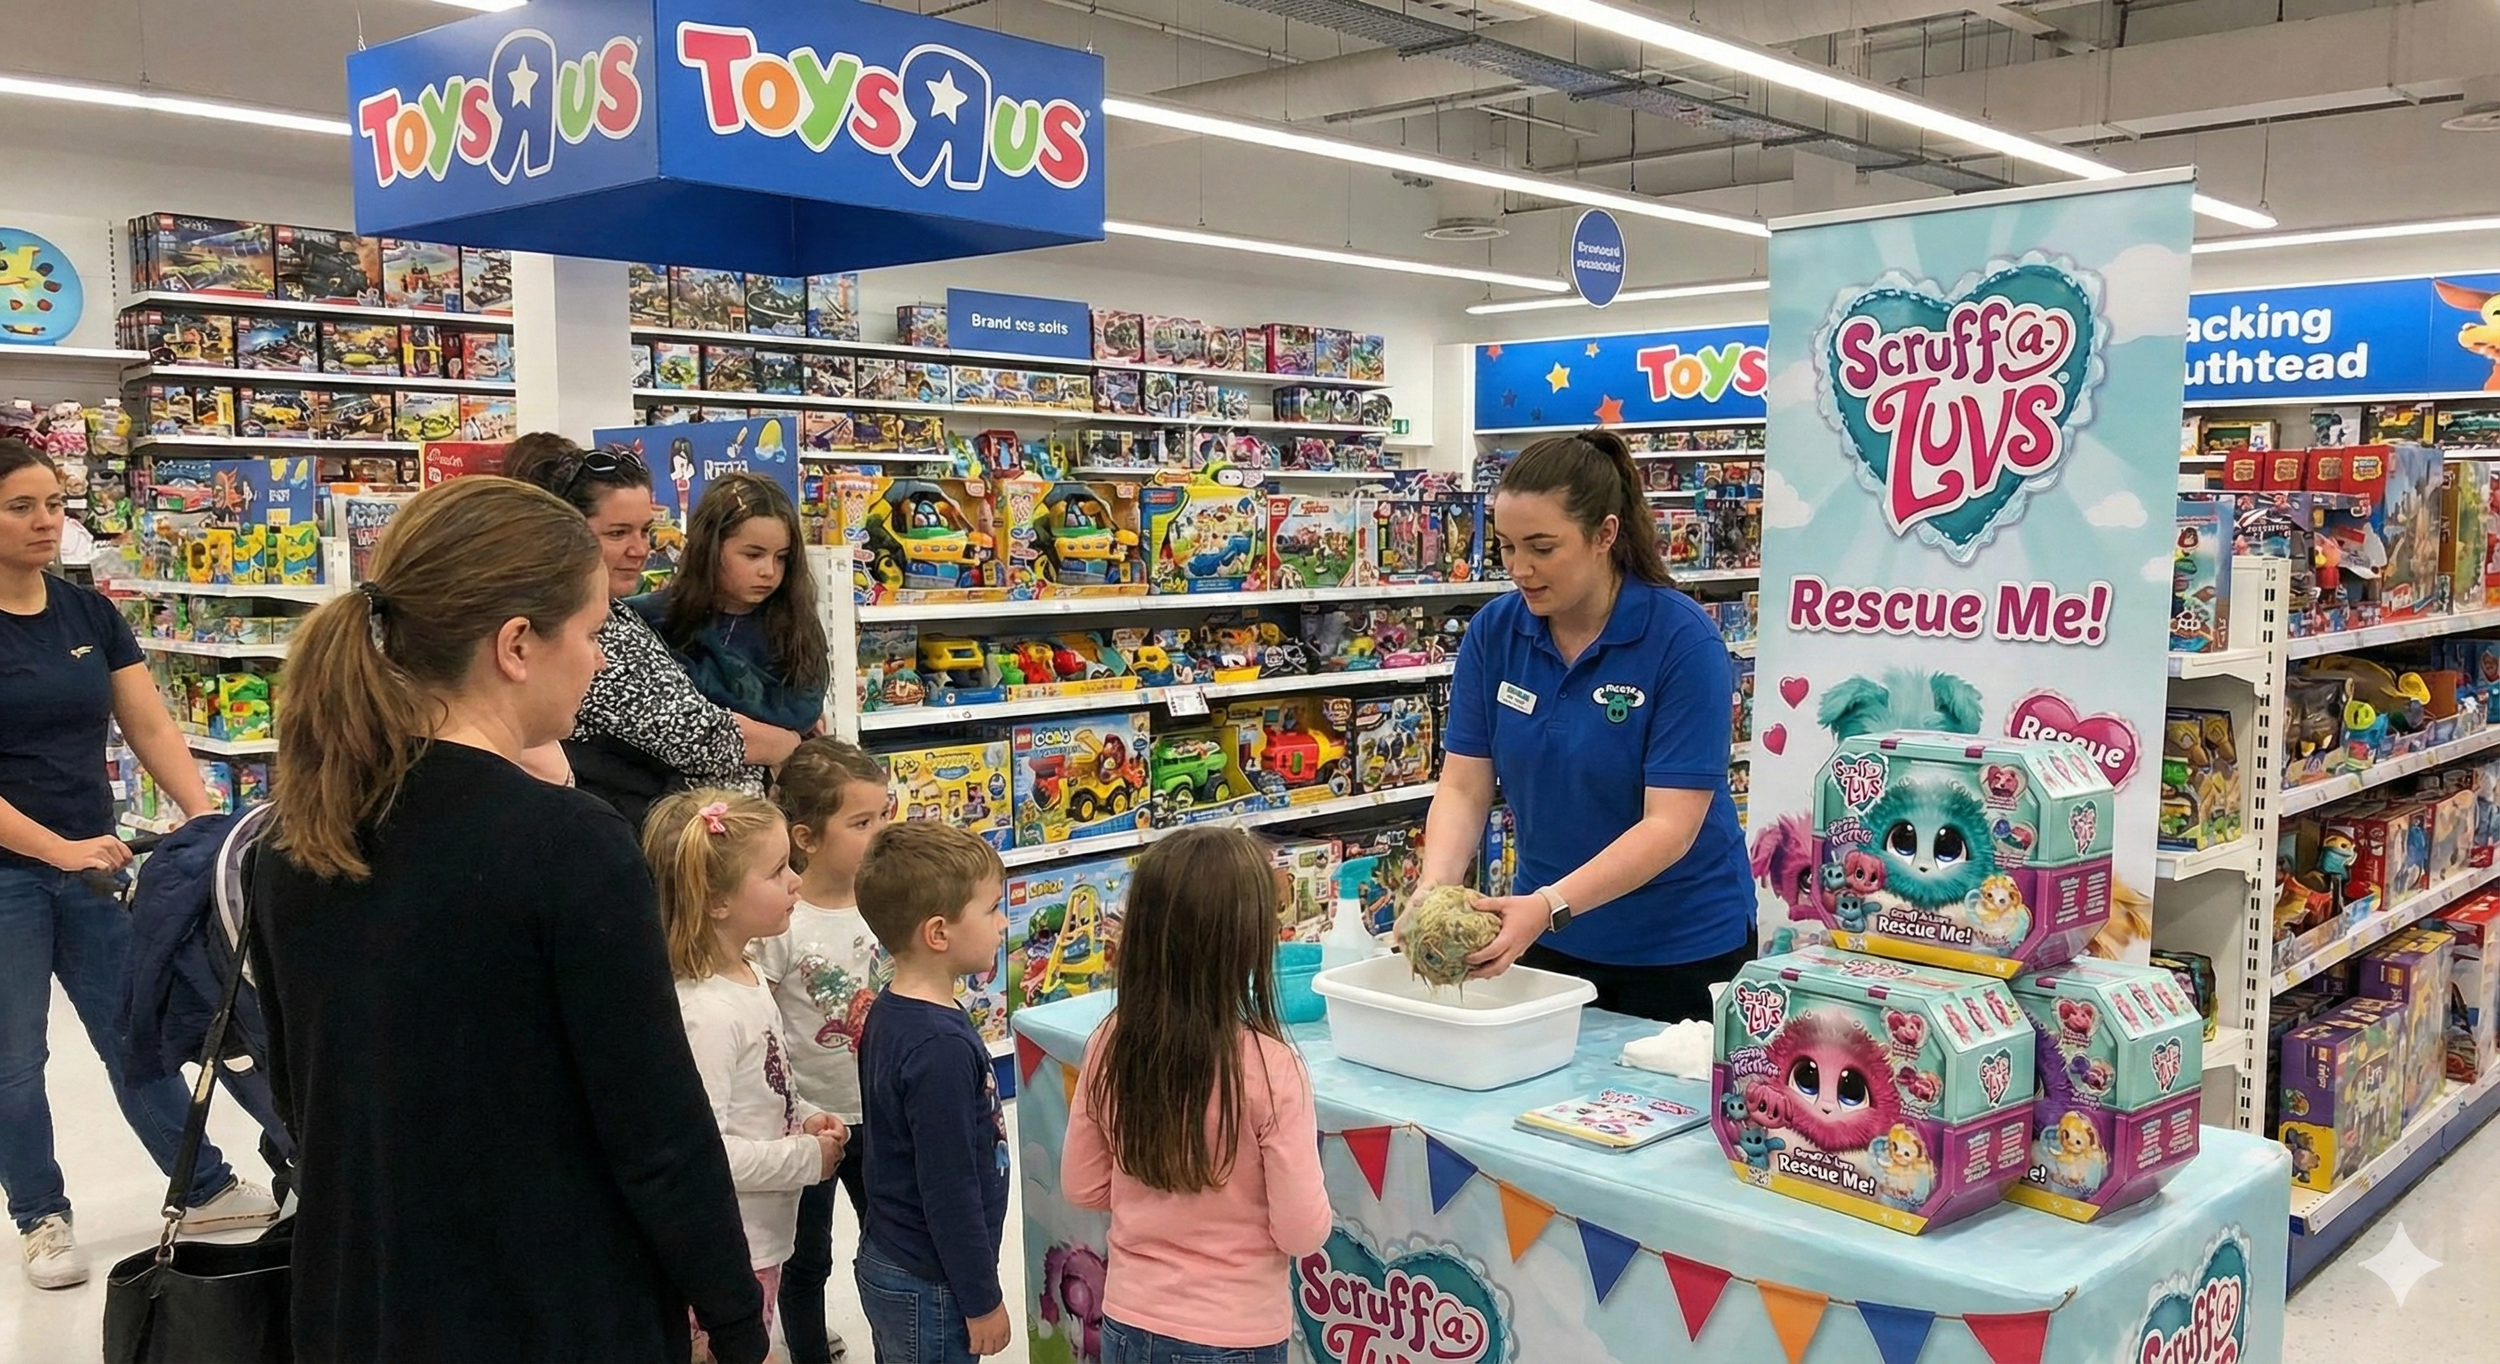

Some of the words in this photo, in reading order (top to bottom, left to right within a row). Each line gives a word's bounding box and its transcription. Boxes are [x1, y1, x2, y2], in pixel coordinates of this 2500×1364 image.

[971, 312, 1012, 330] Brand
[1790, 579, 1982, 640] Rescue
[1995, 584, 2108, 641] Me!
[1878, 915, 1937, 939] Rescue
[1939, 924, 1973, 944] Me!
[1778, 1154, 1839, 1183] Rescue
[1843, 1170, 1876, 1194] Me!
[1301, 1252, 1434, 1352] Scruff
